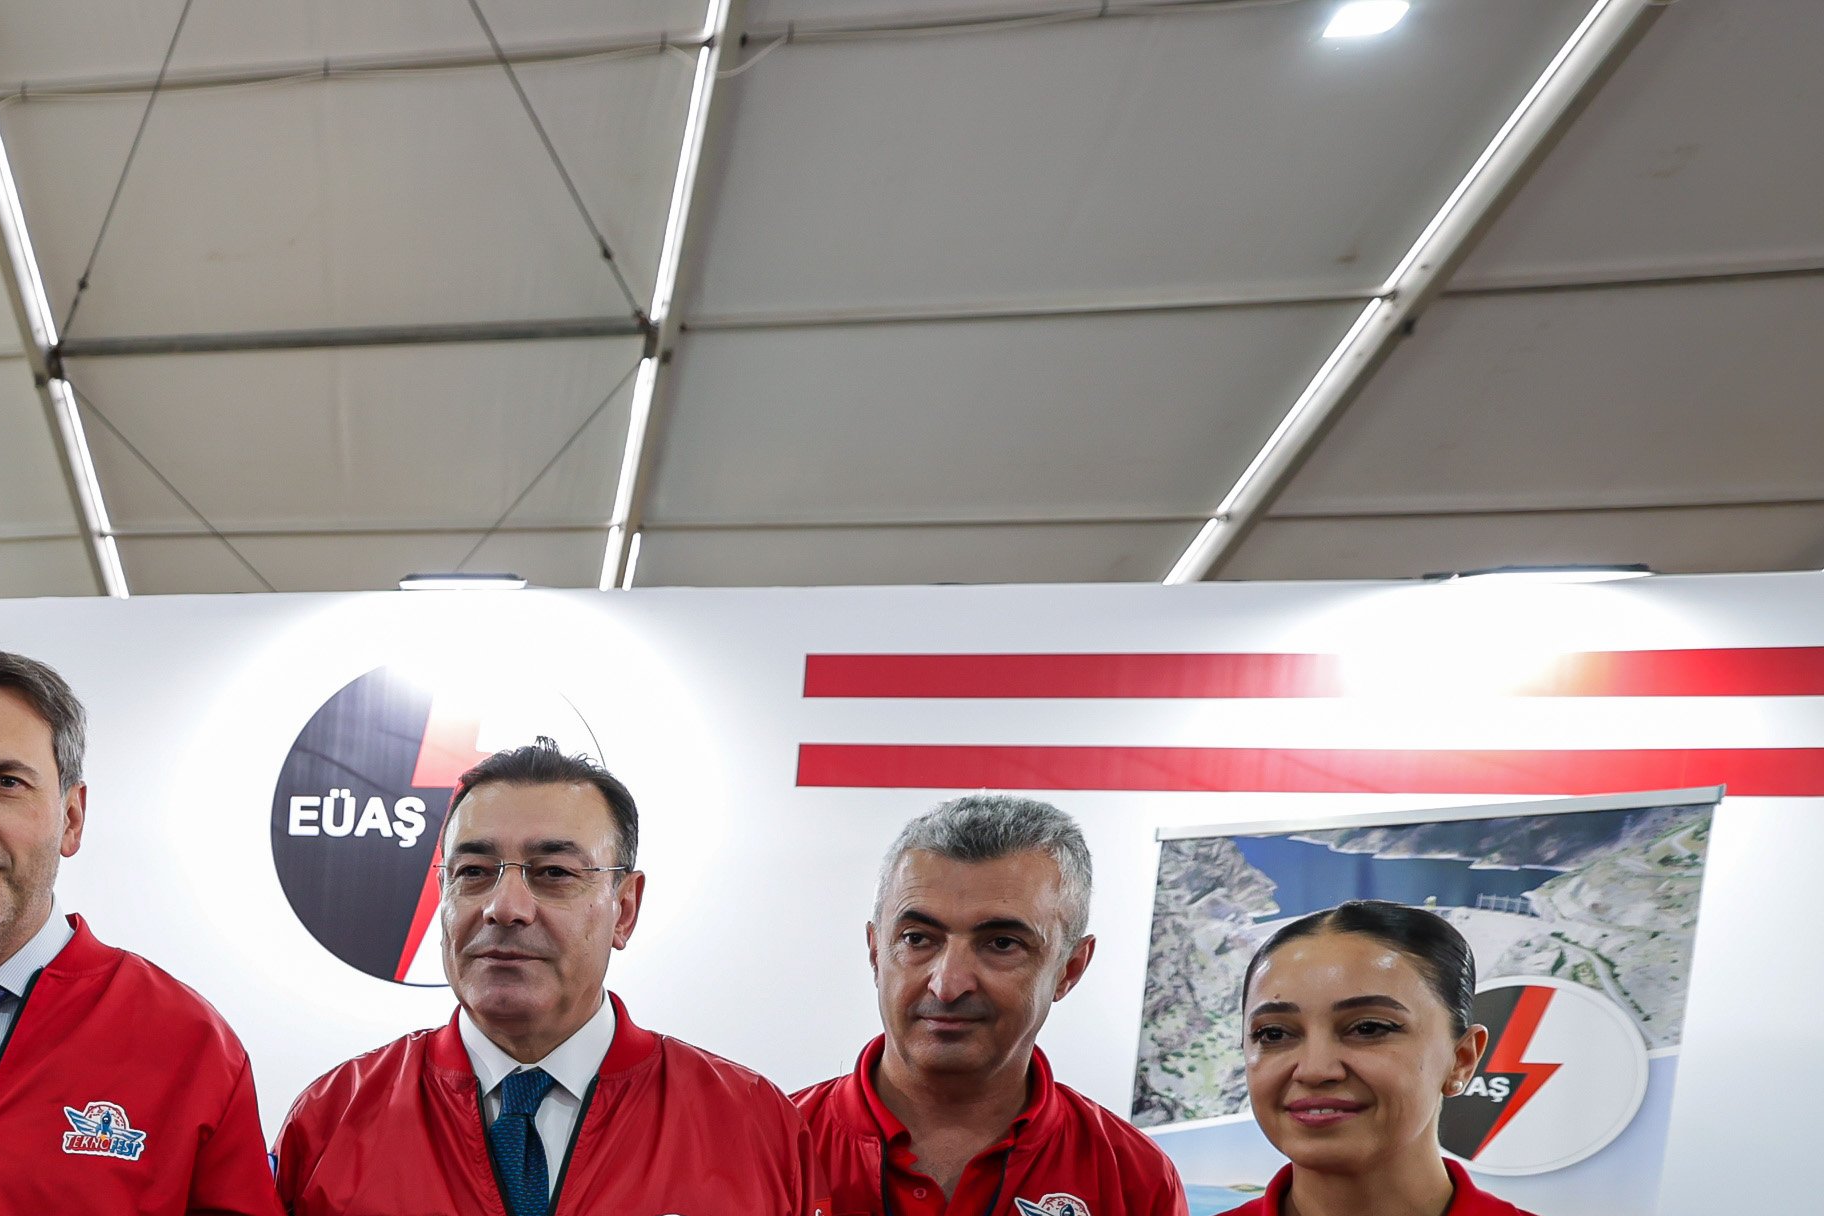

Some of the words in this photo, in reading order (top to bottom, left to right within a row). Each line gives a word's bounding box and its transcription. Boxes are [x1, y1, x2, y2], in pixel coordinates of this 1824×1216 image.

[288, 788, 427, 848] EÜAŞ
[1464, 1076, 1510, 1102] AŞ
[66, 1135, 142, 1157] TEKNOFEST
